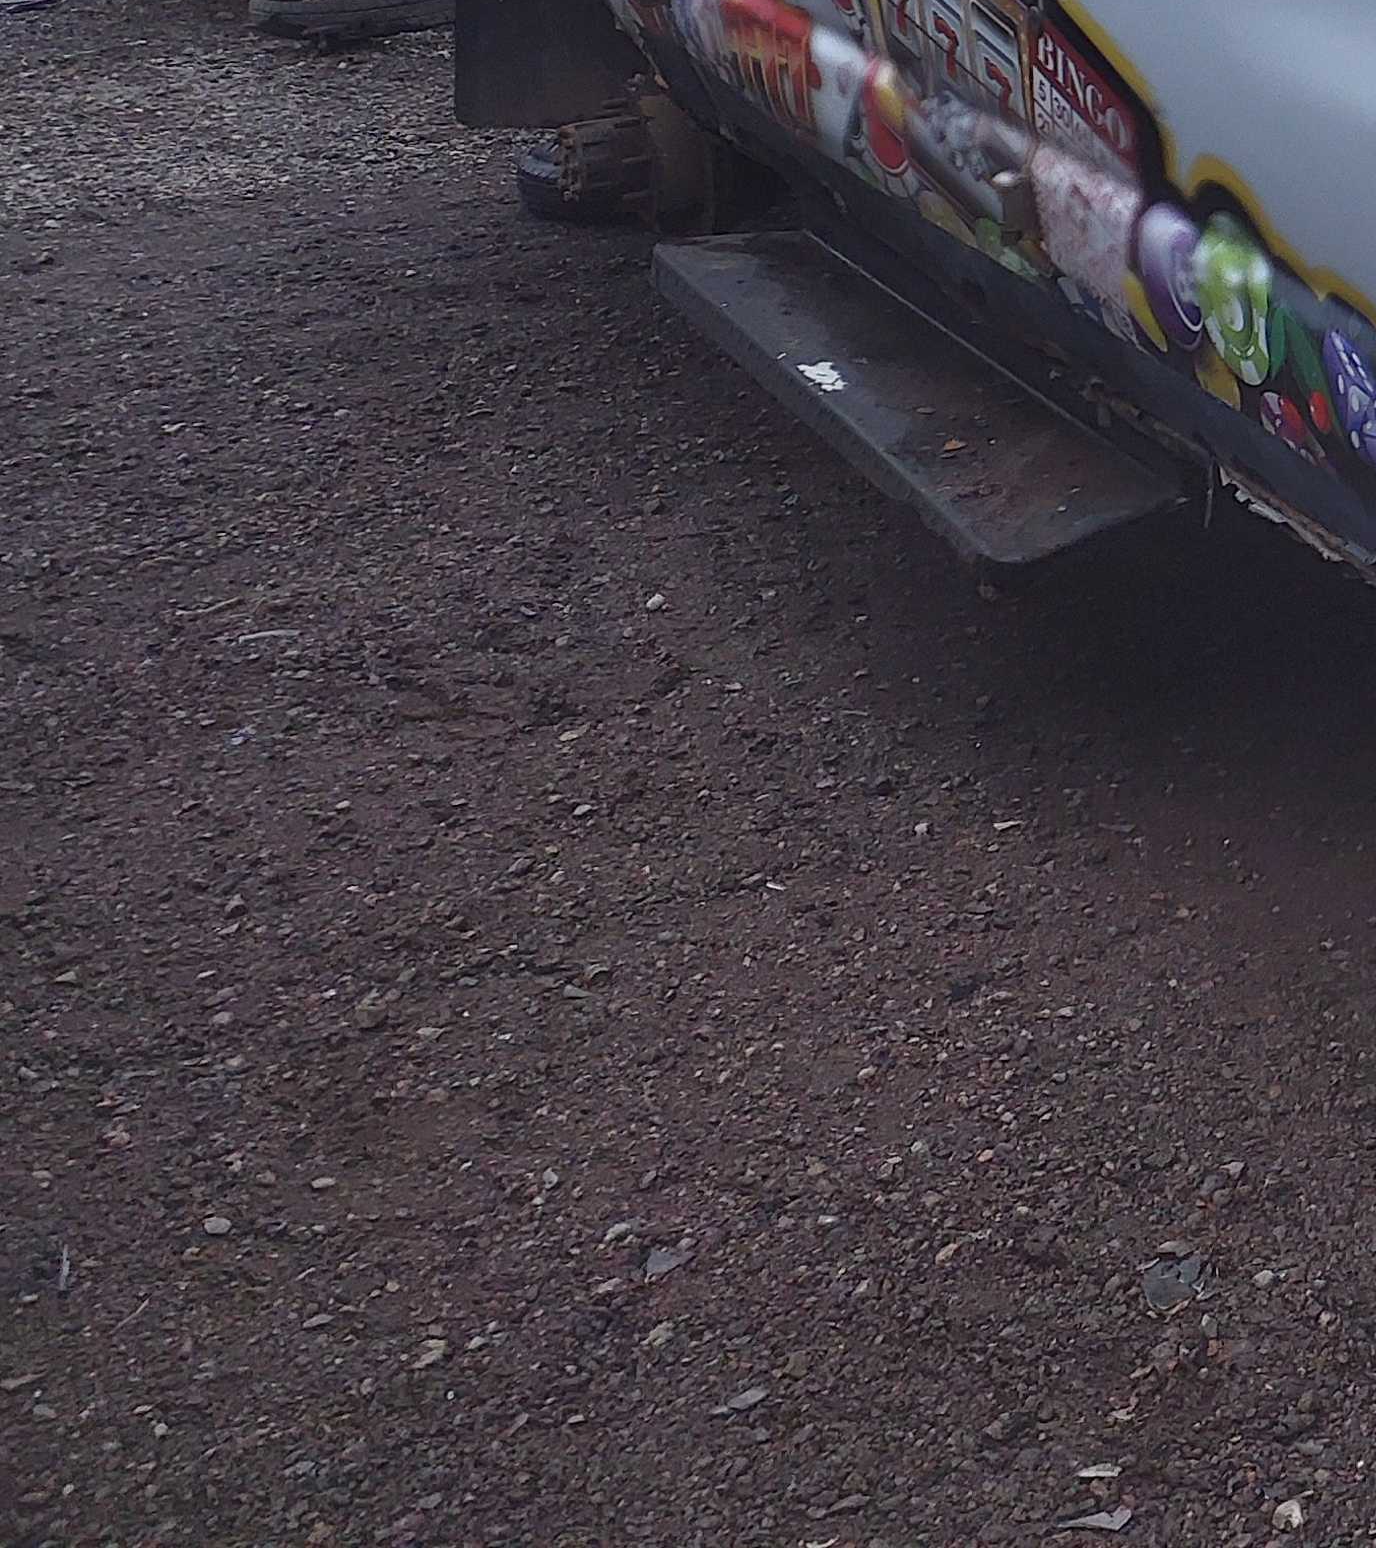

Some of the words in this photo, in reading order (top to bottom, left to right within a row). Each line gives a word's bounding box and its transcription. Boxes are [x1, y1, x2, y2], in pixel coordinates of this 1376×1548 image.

[933, 10, 960, 80] 7
[984, 56, 1013, 119] 7
[1037, 31, 1130, 150] BINGO
[1037, 79, 1047, 102] 5
